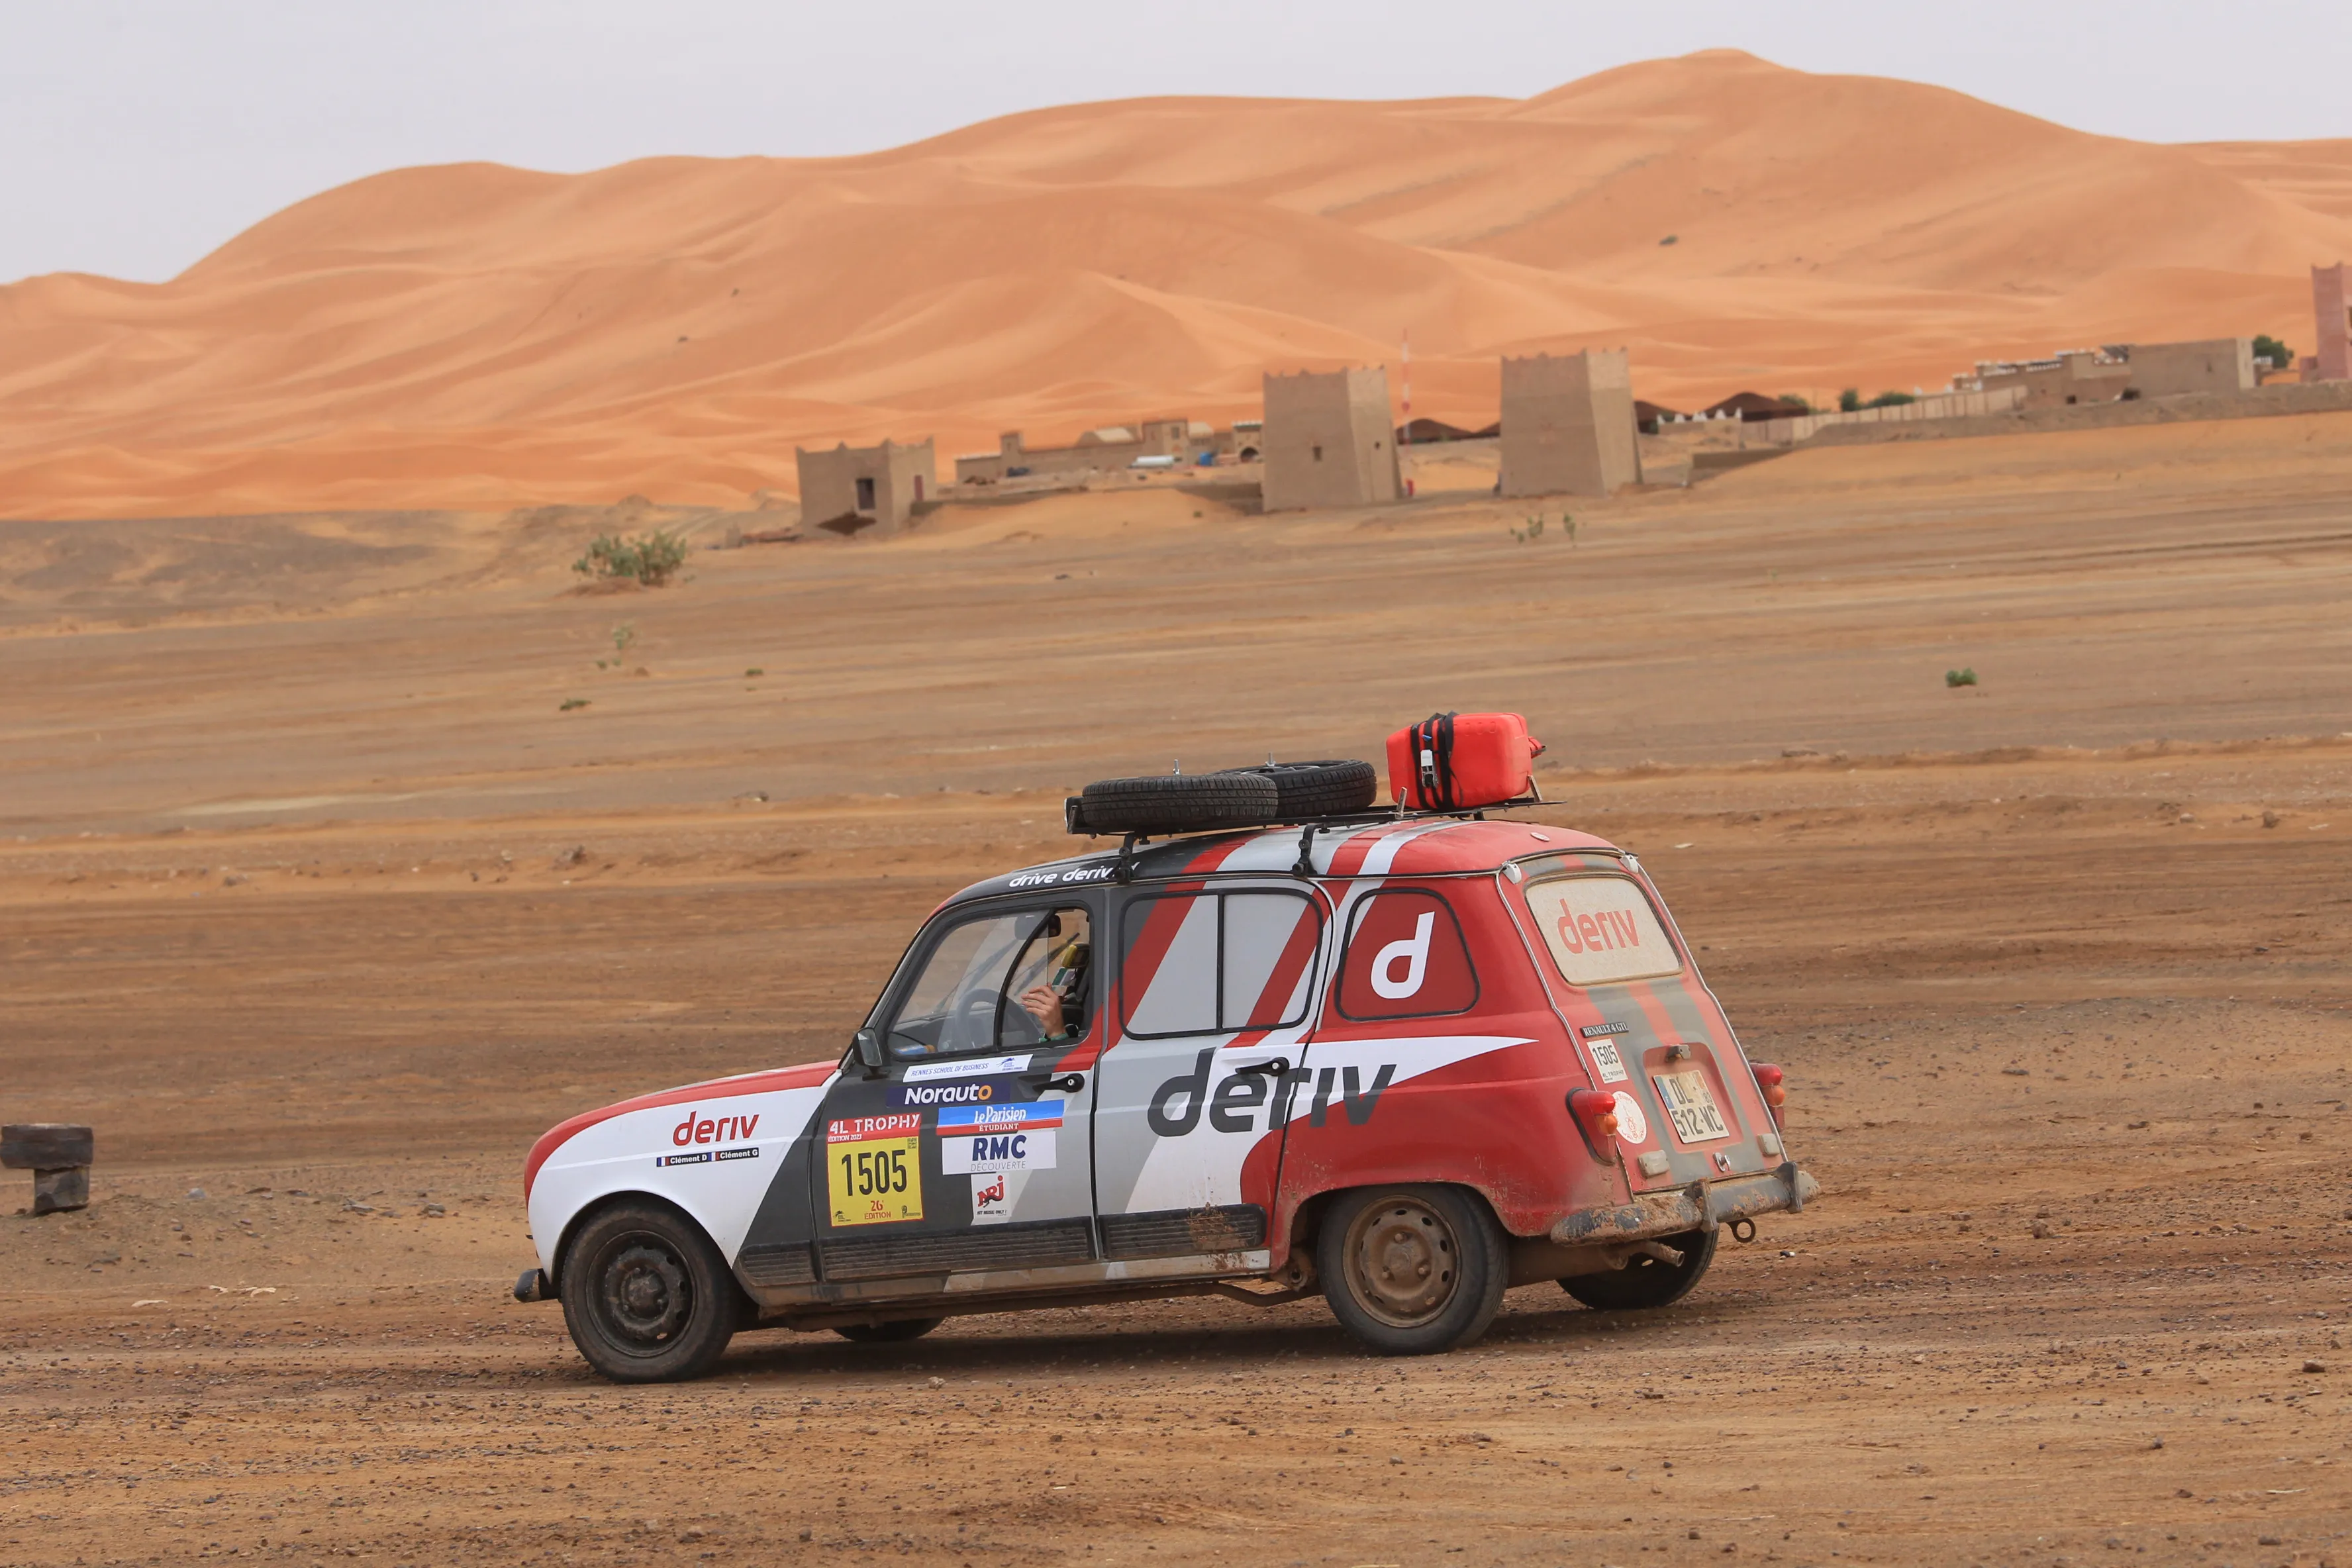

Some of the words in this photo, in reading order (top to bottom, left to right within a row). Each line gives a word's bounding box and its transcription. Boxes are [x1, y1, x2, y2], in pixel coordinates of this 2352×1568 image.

[1009, 873, 1057, 887] drive
[1557, 899, 1640, 954] deriv
[1370, 911, 1435, 999] d
[1583, 1024, 1611, 1036] RENAULT
[1616, 1022, 1629, 1032] GTL
[1592, 1045, 1618, 1066] 1505
[911, 1068, 932, 1077] RENNES
[933, 1065, 954, 1074] SCHOOL
[962, 1063, 989, 1071] BUSINESS
[904, 1083, 993, 1104] Norauto
[1148, 1047, 1396, 1138] deriv
[985, 1105, 1027, 1123] Parisien
[673, 1110, 760, 1146] deriv
[830, 1120, 848, 1134] 4L
[854, 1114, 920, 1133] TROPHY
[979, 1122, 1019, 1132] ÉTUDIANT
[720, 1150, 750, 1159] Clément
[972, 1135, 1027, 1161] RMC
[670, 1155, 700, 1164] Clément
[970, 1160, 1026, 1172] DÉCOUVERTE
[842, 1150, 907, 1197] 1505
[864, 1211, 891, 1220] EDITION
